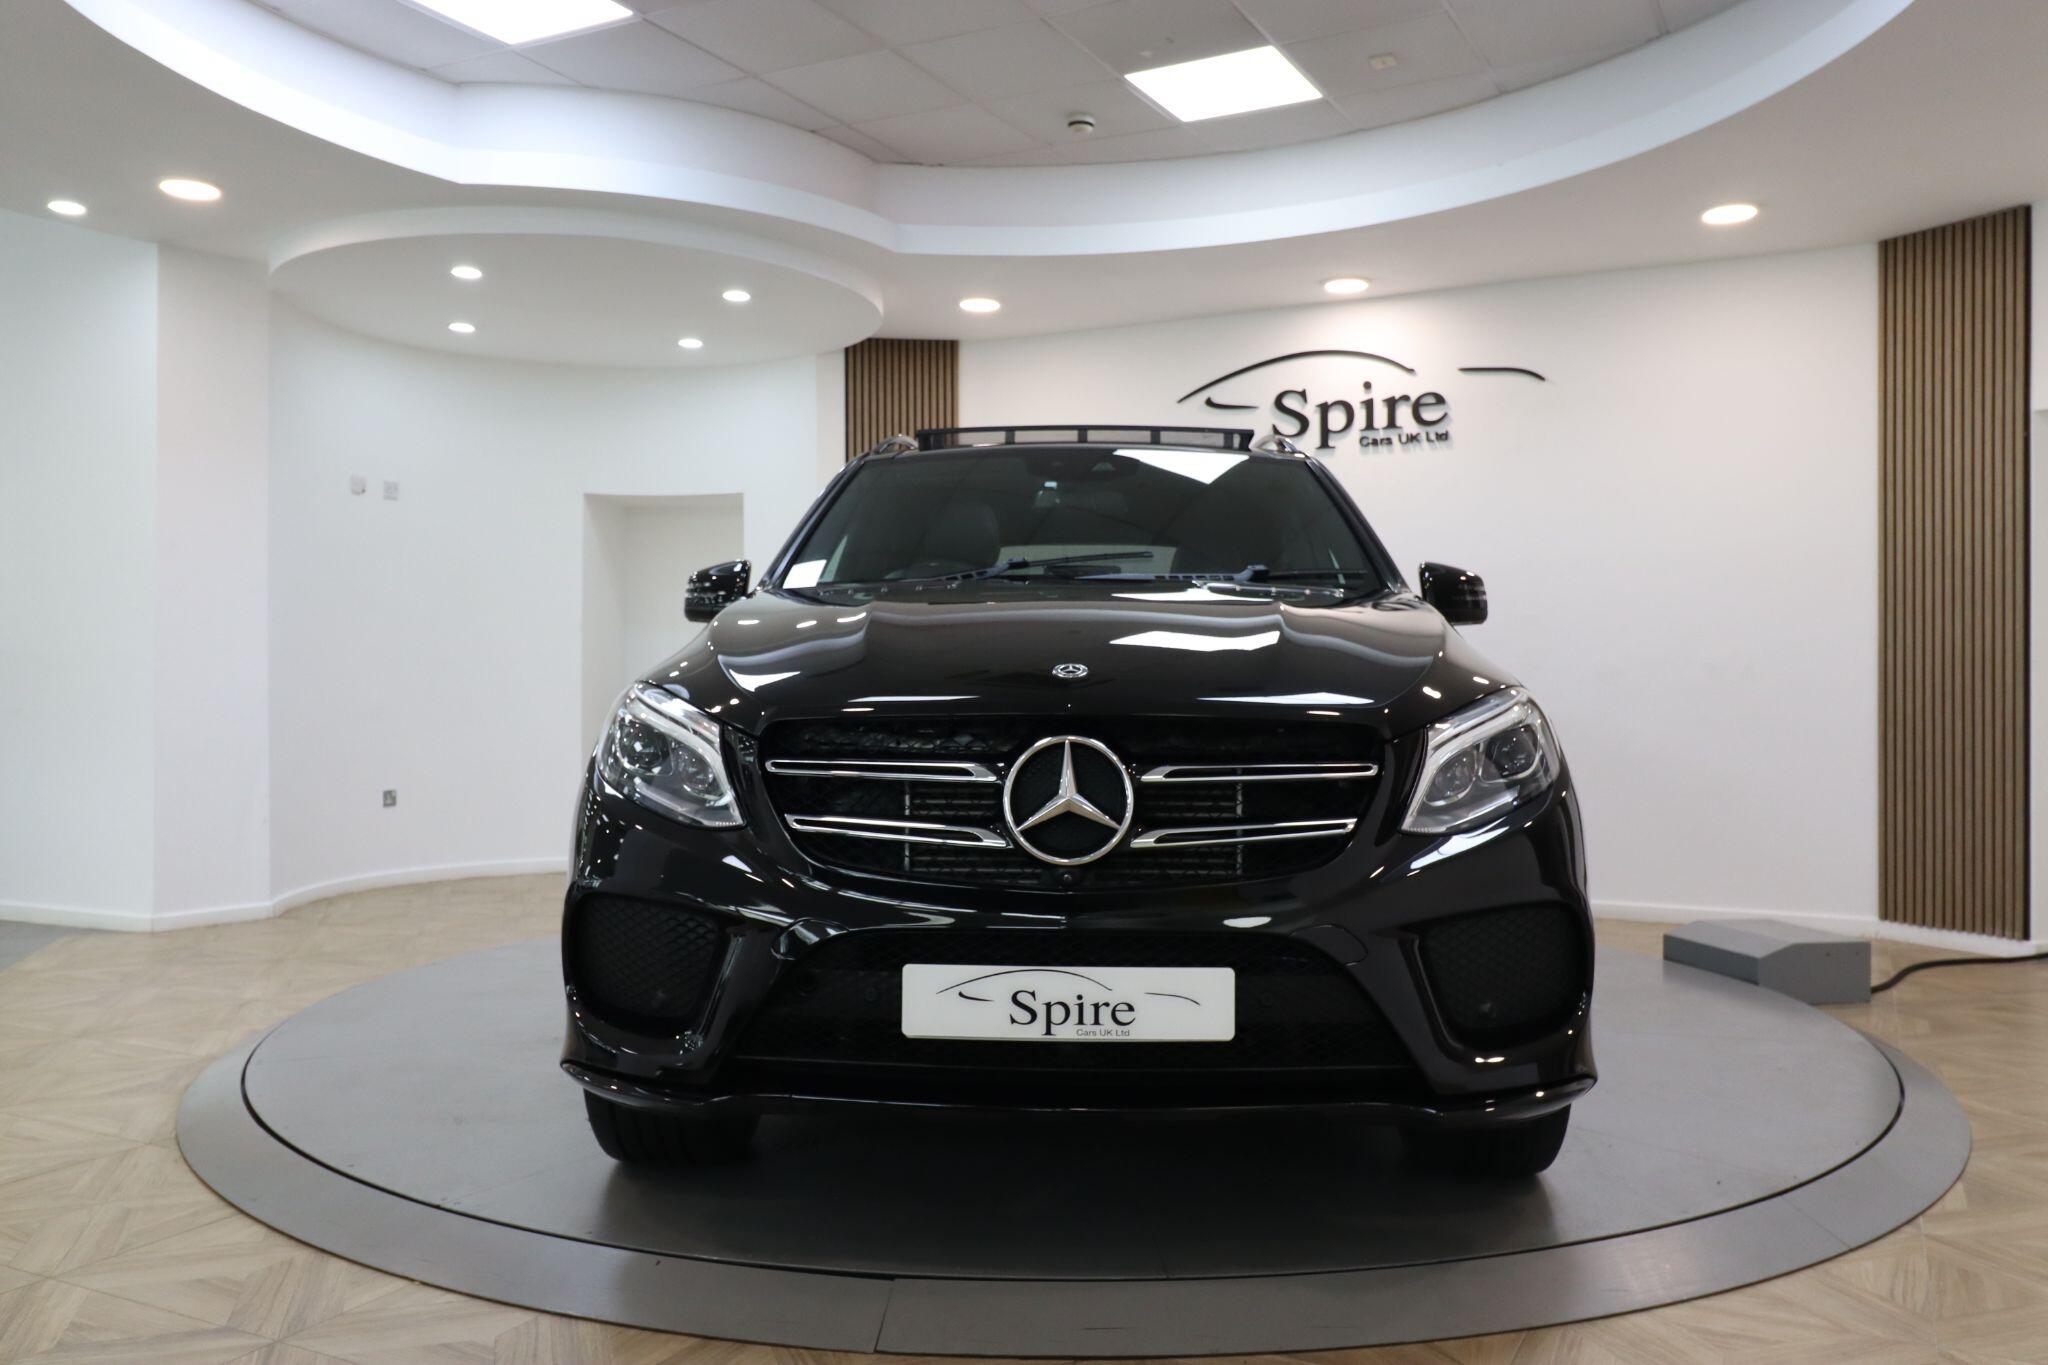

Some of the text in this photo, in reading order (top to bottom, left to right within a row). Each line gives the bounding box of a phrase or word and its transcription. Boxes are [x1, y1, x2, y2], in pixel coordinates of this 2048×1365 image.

[1272, 380, 1449, 450] Spire
[1359, 430, 1449, 448] Cars UK Ltd
[1009, 989, 1136, 1037] Spire
[1076, 1028, 1130, 1037] Cars UK Ltd
